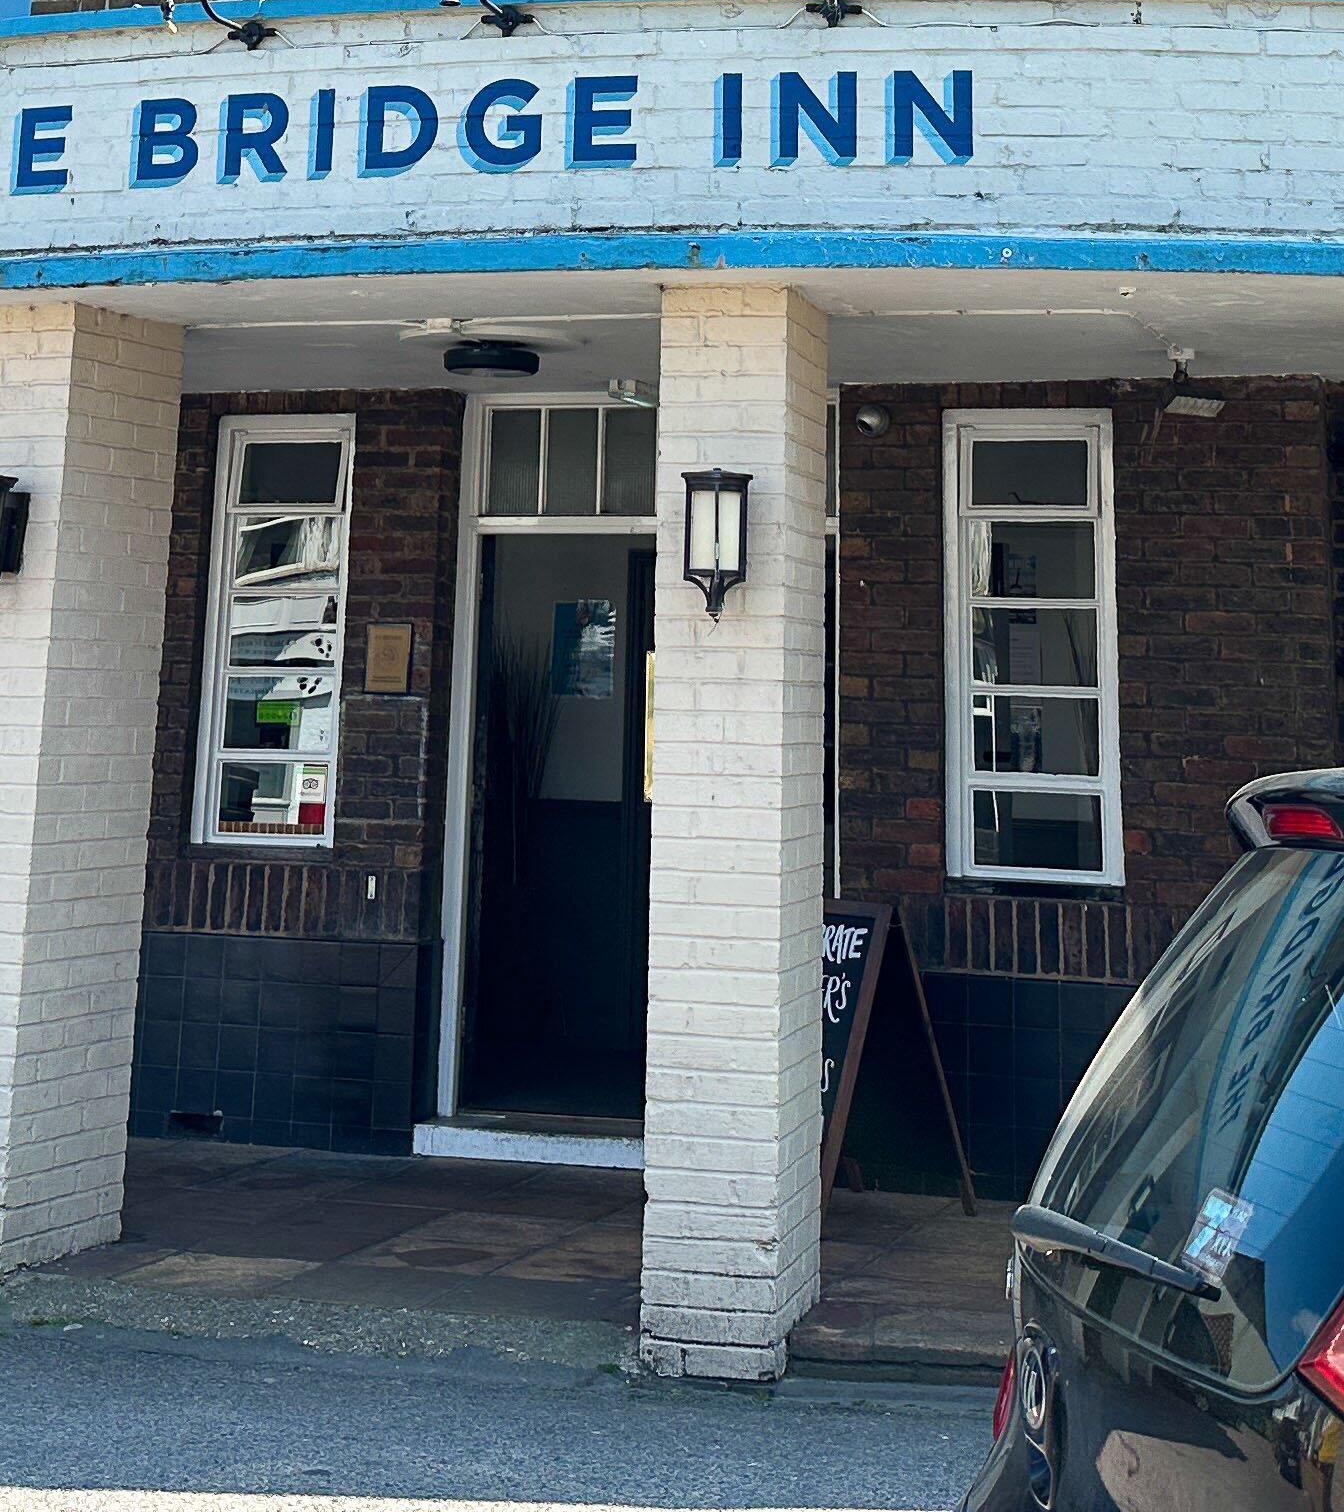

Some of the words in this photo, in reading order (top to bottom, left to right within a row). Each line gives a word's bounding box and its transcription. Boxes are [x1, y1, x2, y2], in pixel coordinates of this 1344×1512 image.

[129, 76, 639, 187] BRIDGE
[712, 69, 975, 168] INN
[821, 924, 868, 964] RATE
